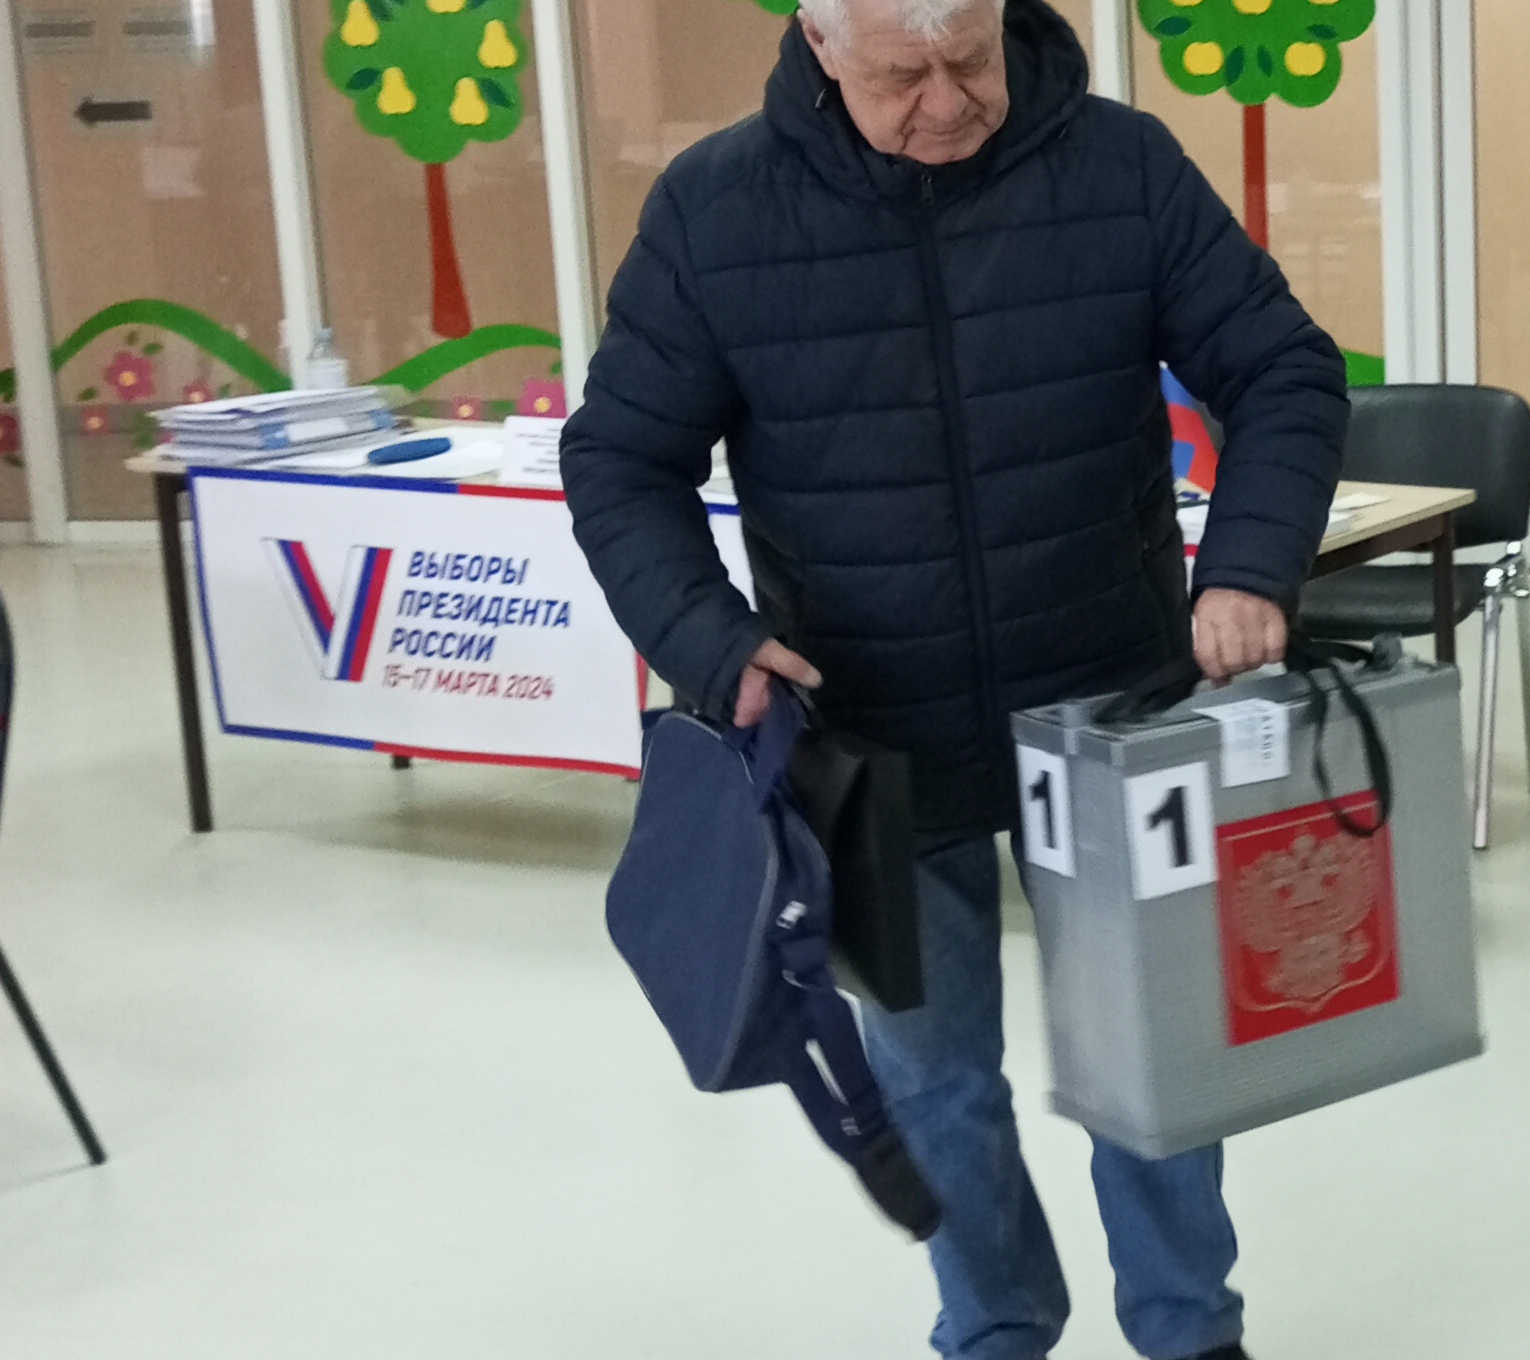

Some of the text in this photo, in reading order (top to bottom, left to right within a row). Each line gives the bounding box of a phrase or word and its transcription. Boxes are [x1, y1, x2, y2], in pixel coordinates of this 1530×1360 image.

[407, 550, 530, 585] ВЫБОРЫ
[397, 589, 570, 628] ПРЕЗИДЕНТА
[387, 627, 497, 663] РОССИИ
[433, 668, 500, 696] МАРТА
[502, 674, 555, 700] 2024
[1029, 769, 1058, 850] 1
[1147, 785, 1194, 868] 1
